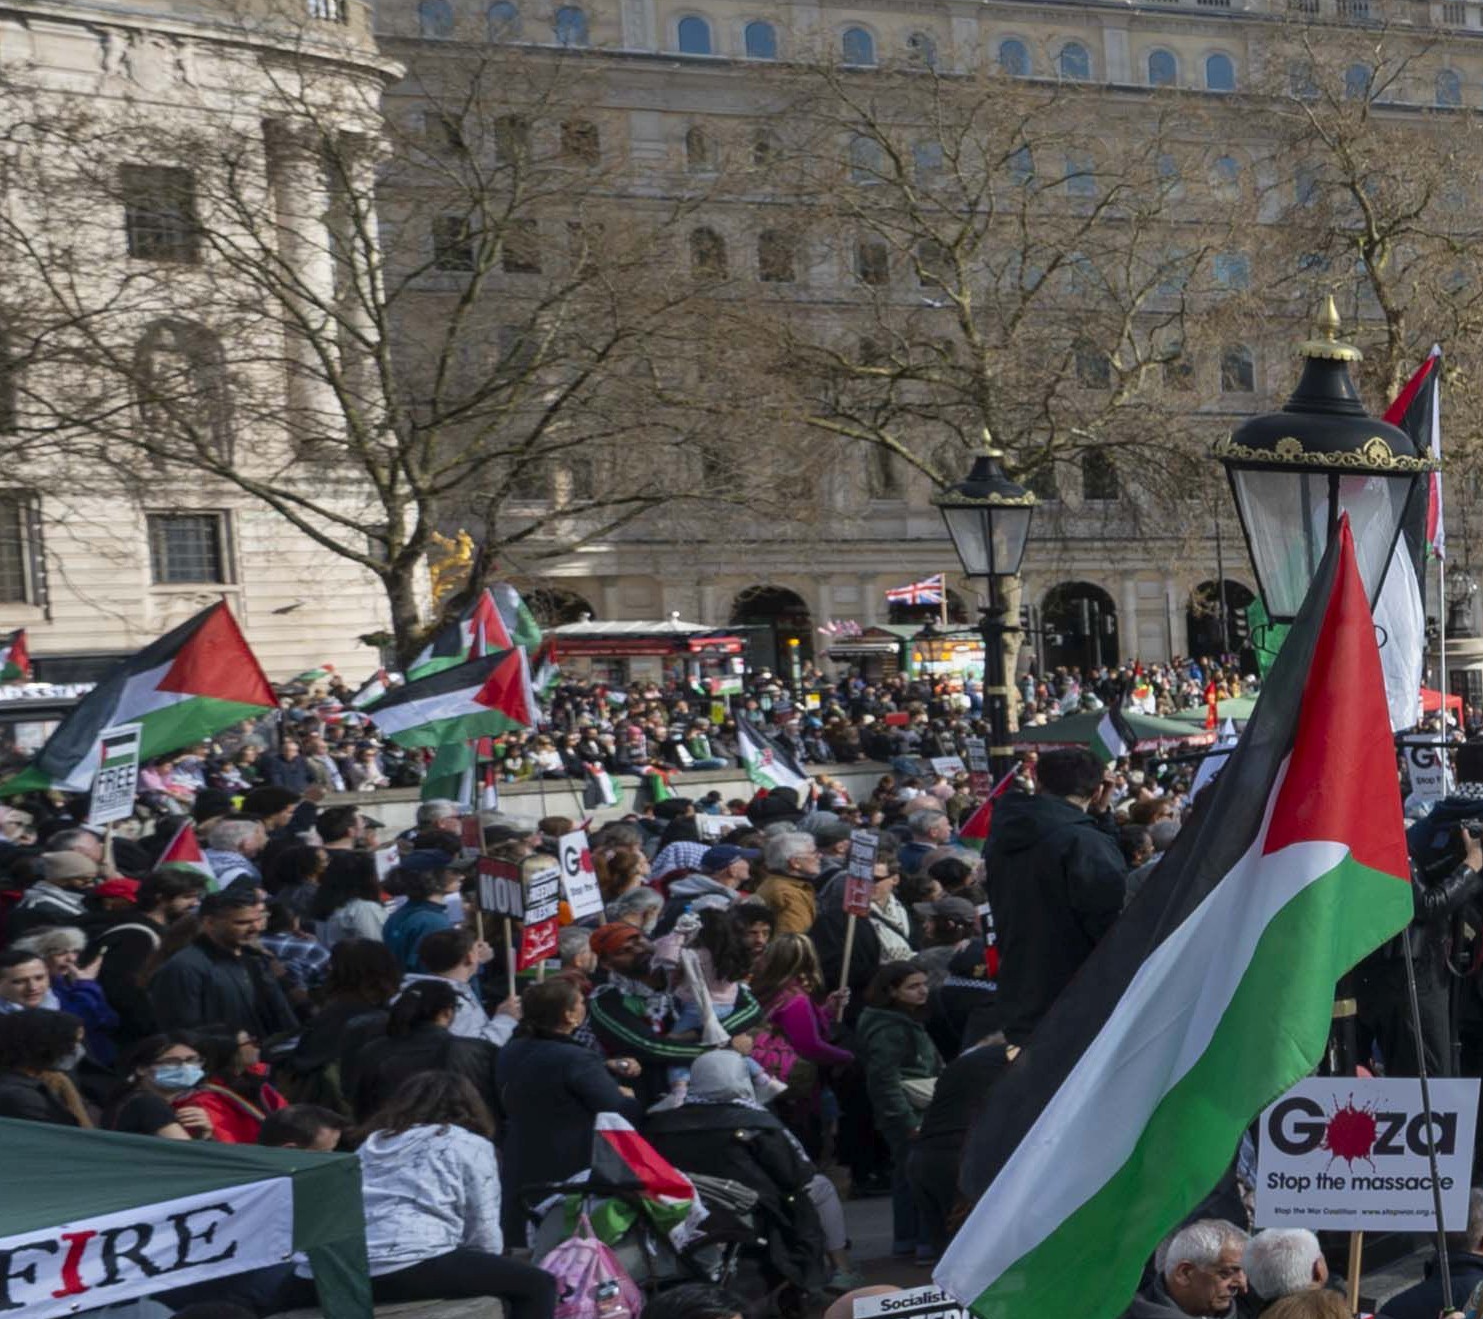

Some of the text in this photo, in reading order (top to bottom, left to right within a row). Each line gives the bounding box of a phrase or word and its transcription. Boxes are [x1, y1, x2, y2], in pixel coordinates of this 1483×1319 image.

[1268, 1096, 1458, 1157] Gza
[1266, 1172, 1454, 1194] Stop the massacre
[881, 1290, 950, 1312] Socialist
